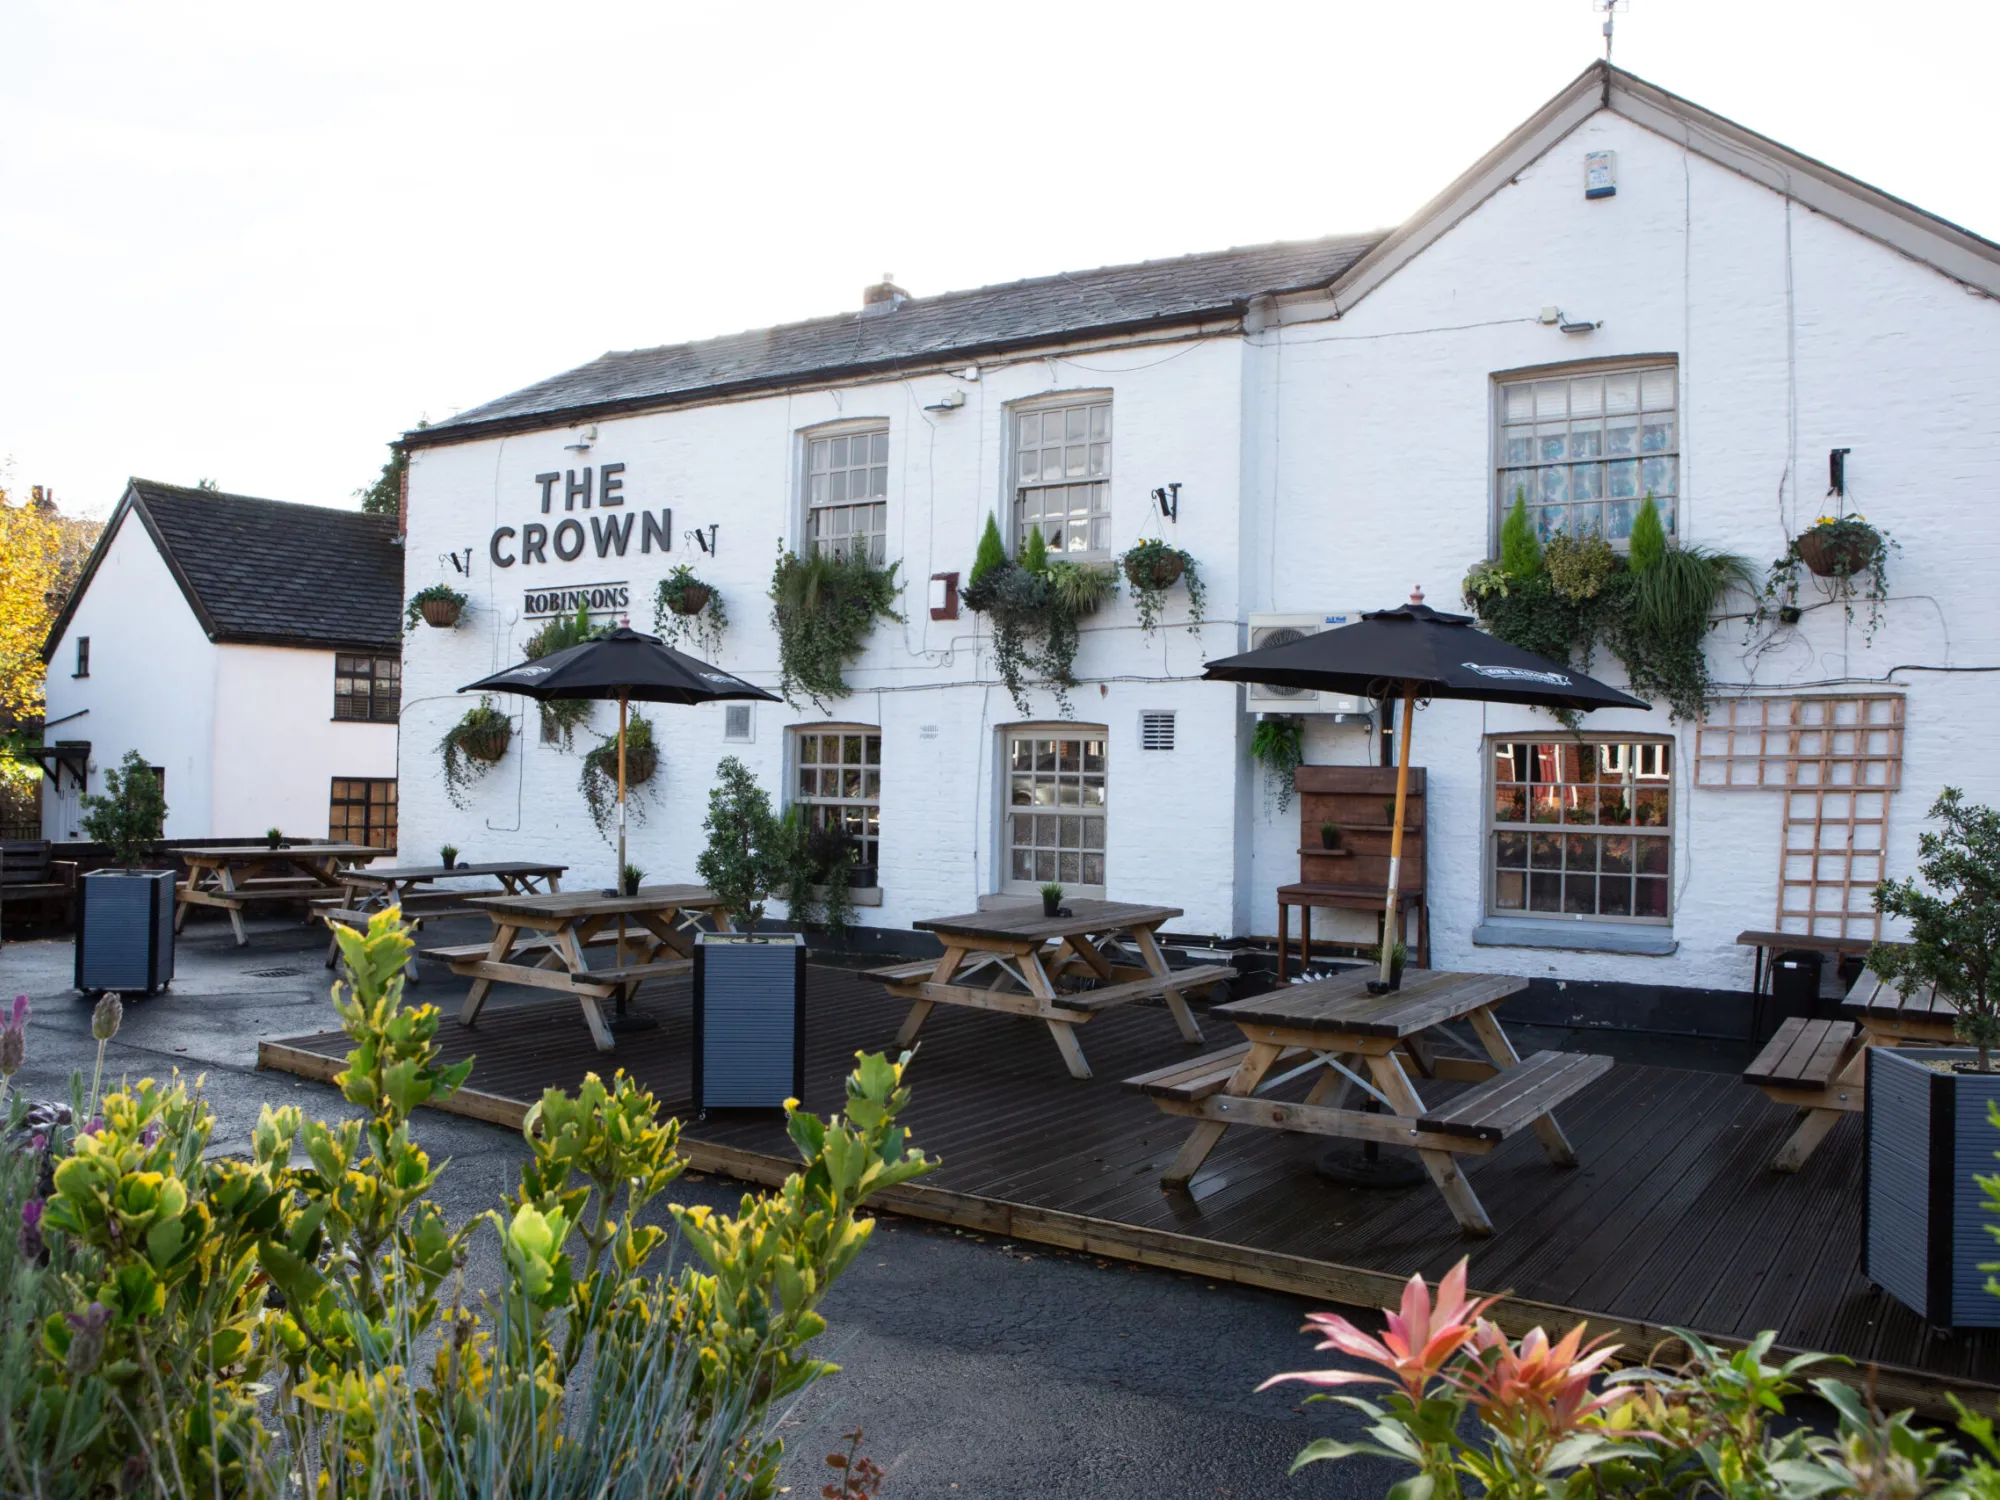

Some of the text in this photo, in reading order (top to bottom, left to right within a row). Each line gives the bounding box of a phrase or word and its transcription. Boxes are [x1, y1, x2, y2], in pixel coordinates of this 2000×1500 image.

[535, 462, 625, 514] THE
[489, 508, 672, 568] CROWN
[524, 587, 629, 613] ROBINSONS
